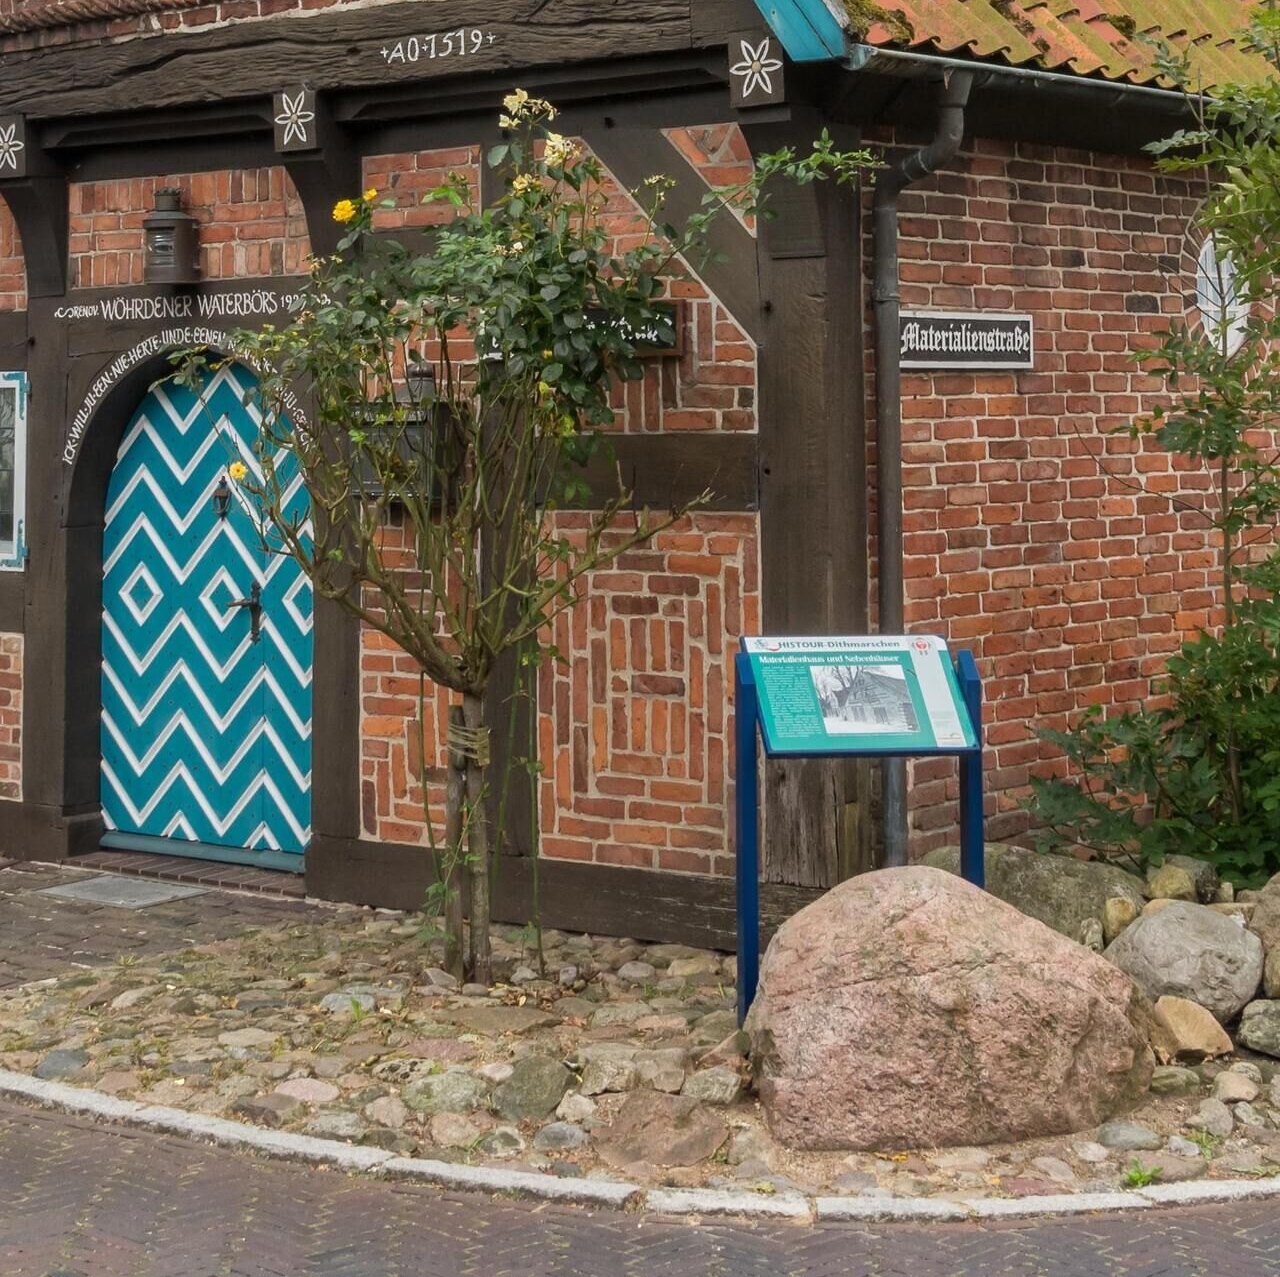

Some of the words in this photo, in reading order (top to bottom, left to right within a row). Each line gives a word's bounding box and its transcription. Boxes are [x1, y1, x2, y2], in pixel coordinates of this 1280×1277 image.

[424, 28, 483, 59] 1519
[100, 296, 192, 321] WÖHRDENER
[197, 289, 278, 320] WATERBÖRS
[900, 322, 1030, 355] Materialienstraße
[759, 655, 825, 664] Materialienhaus
[826, 655, 843, 663] und
[844, 654, 900, 663] Nebenhäuser
[778, 639, 901, 649] HISTOUR-Dithmarschen
